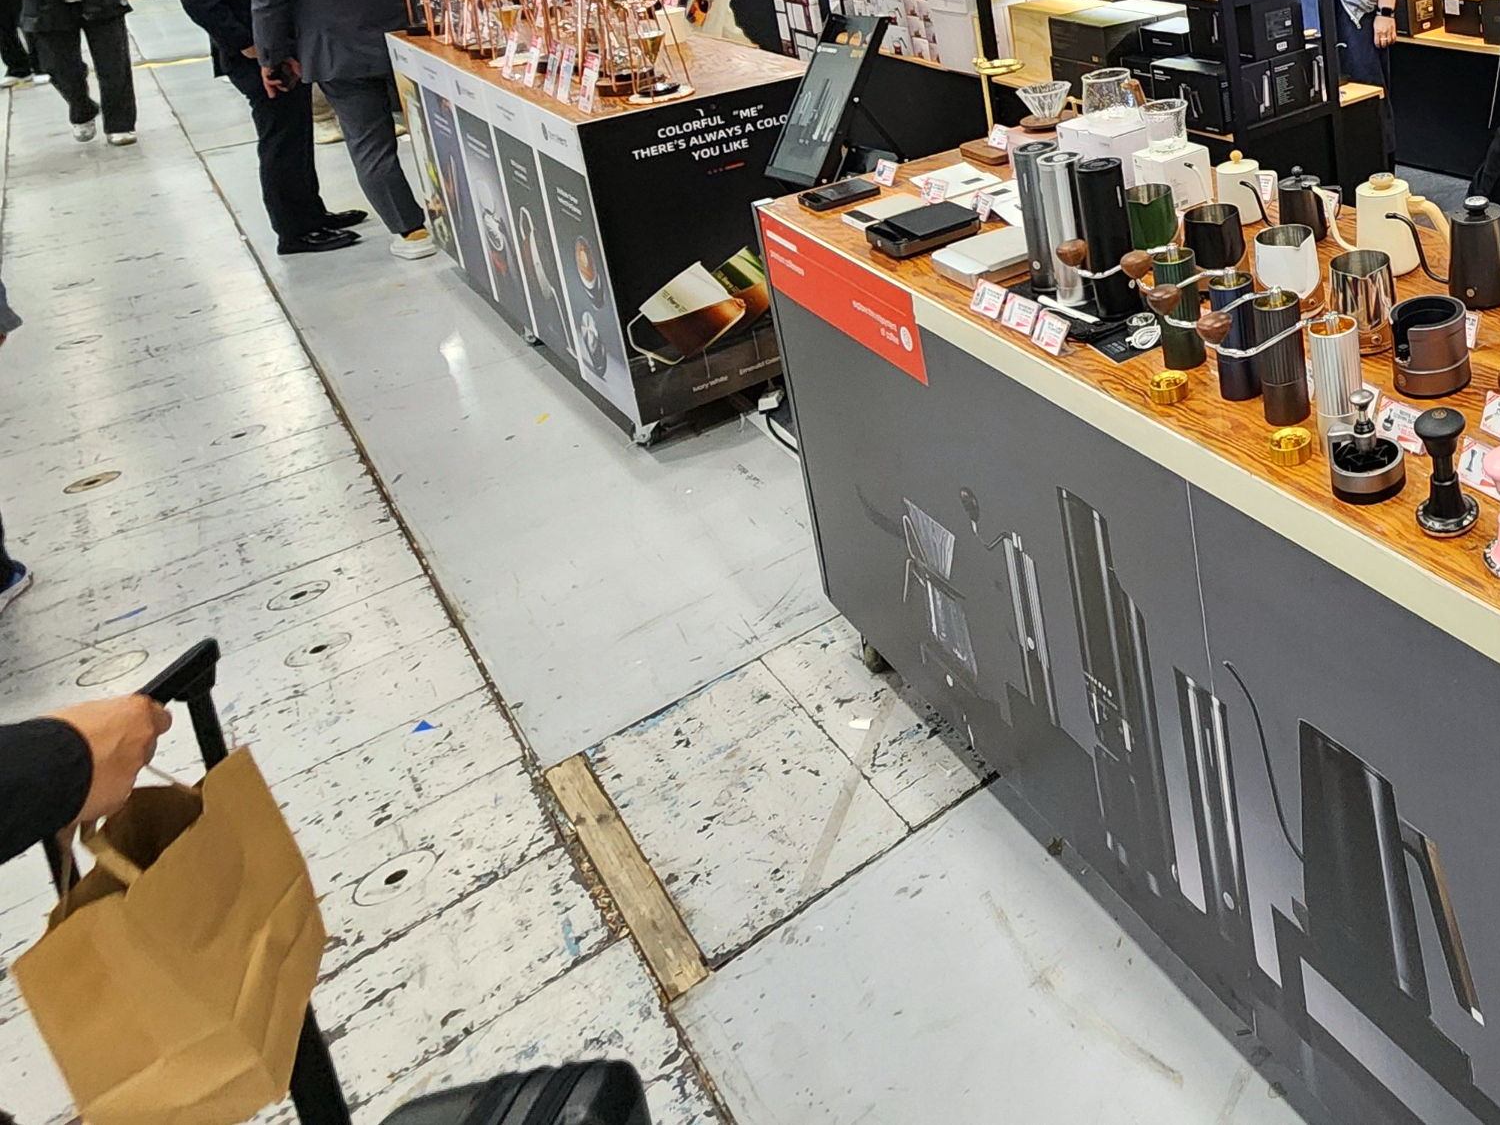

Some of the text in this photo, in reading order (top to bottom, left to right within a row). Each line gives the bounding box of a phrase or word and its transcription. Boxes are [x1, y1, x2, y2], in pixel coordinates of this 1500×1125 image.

[632, 114, 789, 161] THERE'S ALWAYS A COLO
[657, 115, 725, 139] COLORFUL
[691, 138, 749, 161] YOU LIKE
